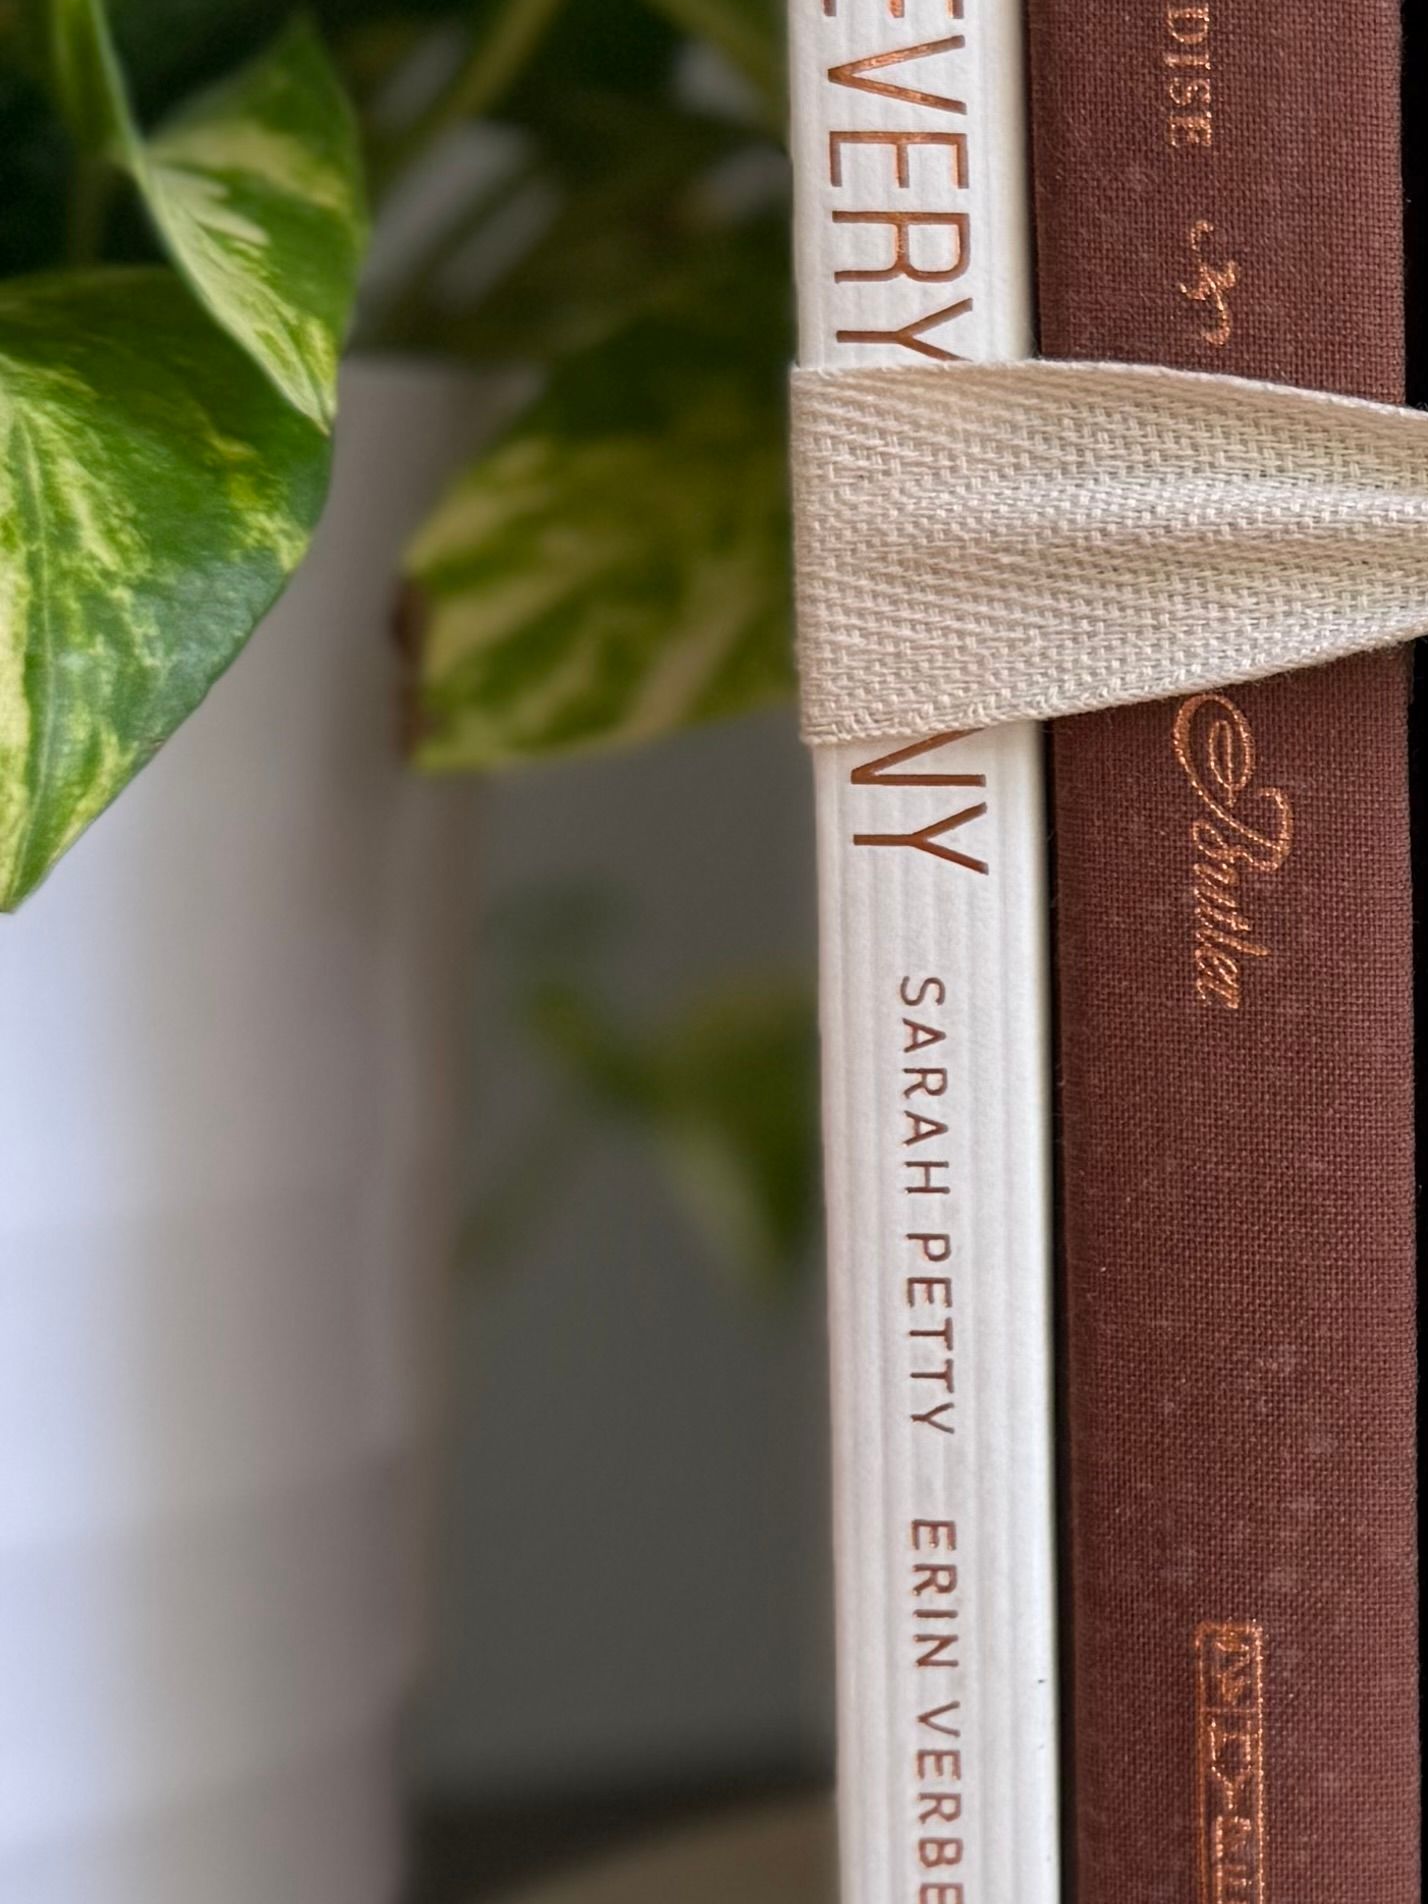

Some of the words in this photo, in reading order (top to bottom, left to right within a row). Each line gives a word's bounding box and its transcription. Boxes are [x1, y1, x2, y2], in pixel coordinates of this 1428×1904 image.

[1169, 693, 1294, 1011] Butler
[900, 977, 949, 1193] SARAH
[907, 1233, 953, 1433] PETTY
[912, 1520, 958, 1667] ERIN
